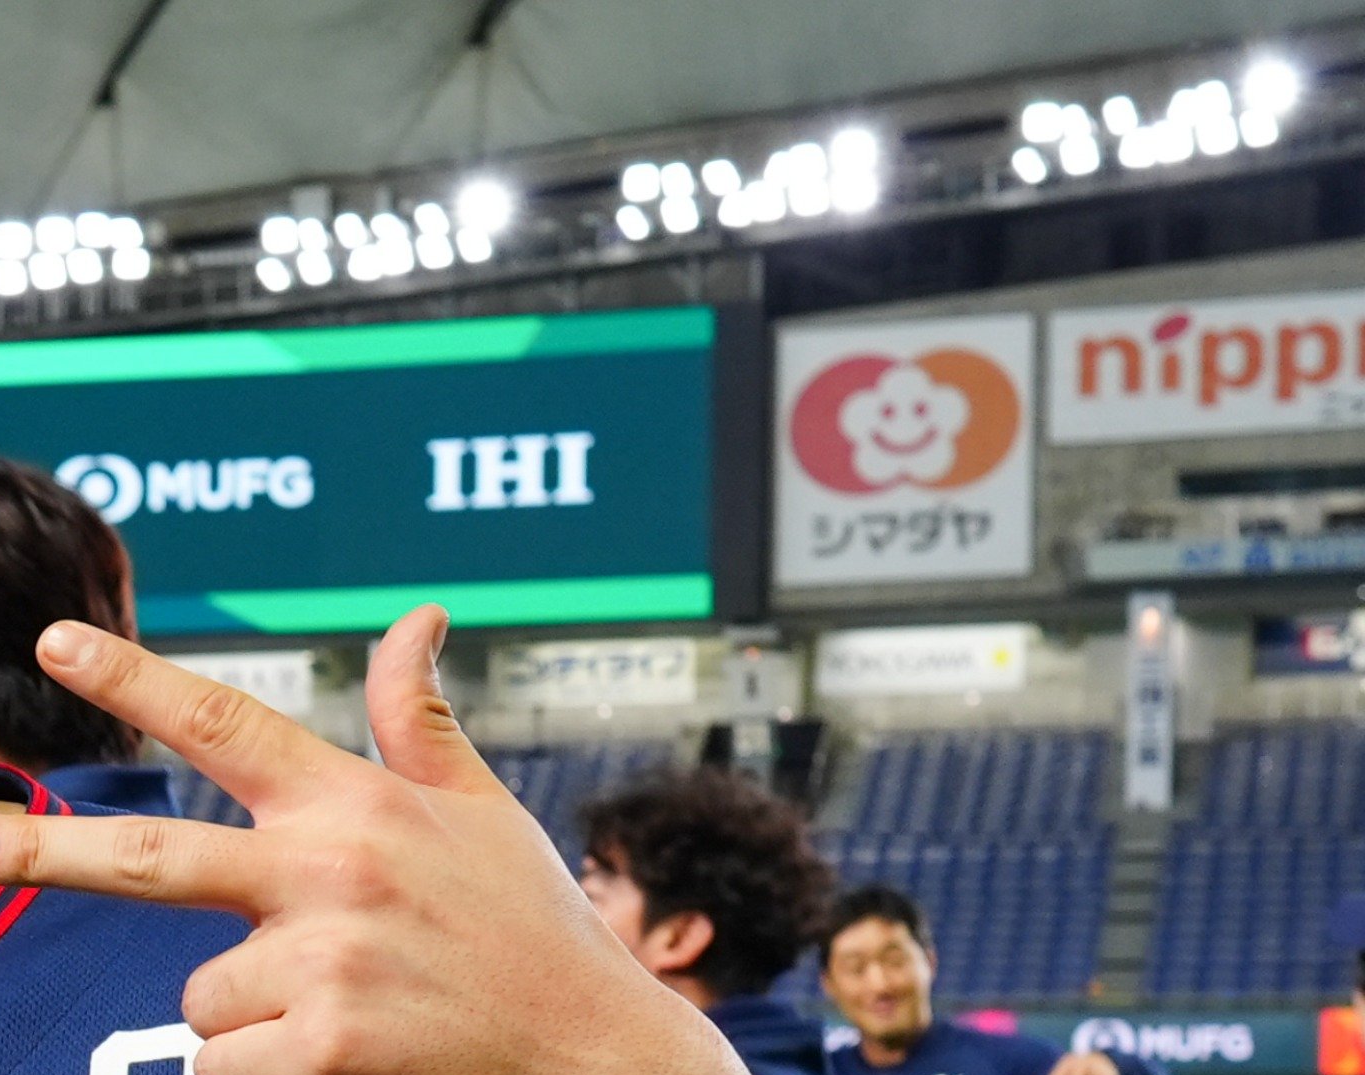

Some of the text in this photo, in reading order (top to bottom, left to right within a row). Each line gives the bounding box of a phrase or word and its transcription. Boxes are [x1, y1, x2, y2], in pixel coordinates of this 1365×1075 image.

[1079, 313, 1365, 407] nipp
[145, 455, 315, 513] MUFG
[426, 430, 595, 512] IHI
[811, 502, 995, 559] シマダヤ
[1136, 1022, 1255, 1063] MUFG
